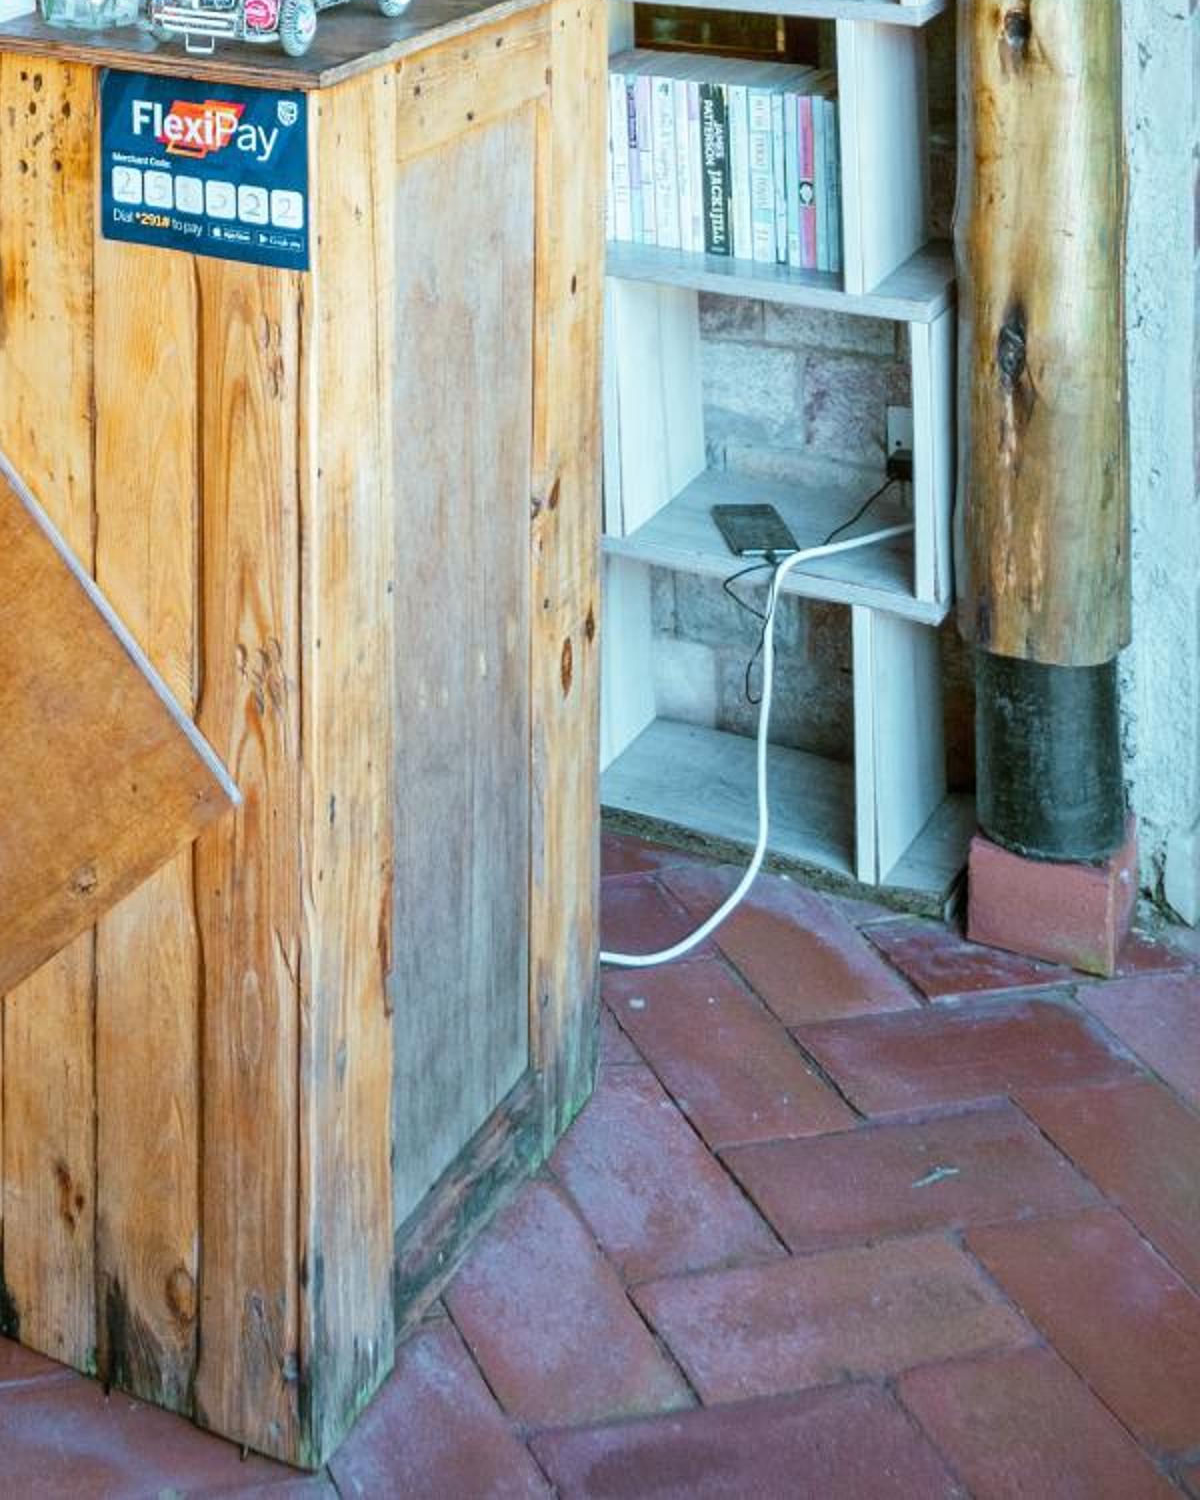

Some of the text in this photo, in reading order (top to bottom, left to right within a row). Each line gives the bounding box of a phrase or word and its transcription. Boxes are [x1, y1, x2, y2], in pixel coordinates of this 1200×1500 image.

[132, 99, 279, 162] FlexiPay
[703, 99, 716, 166] PATTERSON
[713, 121, 725, 158] JAMES
